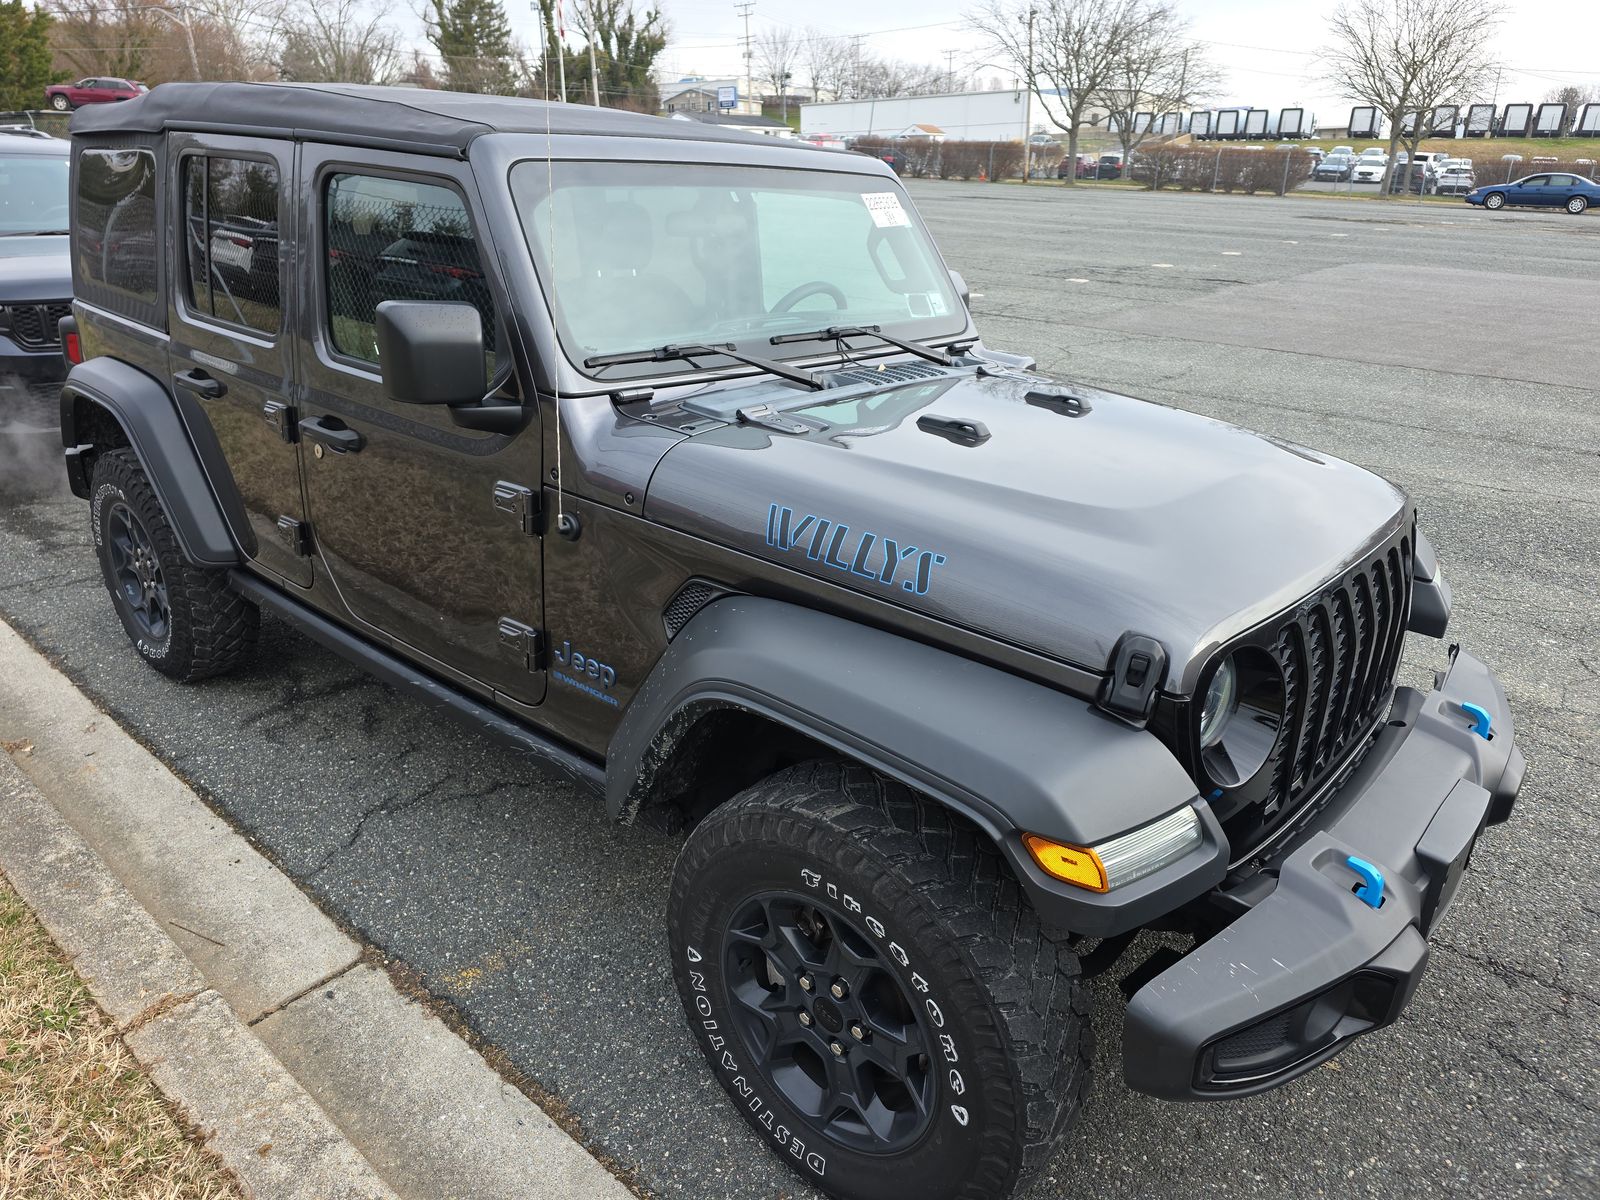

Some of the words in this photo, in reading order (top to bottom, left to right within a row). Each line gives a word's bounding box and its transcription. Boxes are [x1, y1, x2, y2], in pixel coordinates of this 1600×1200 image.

[766, 503, 947, 596] WILLYS
[554, 641, 616, 689] Jeep
[688, 971, 827, 1176] DESTINATION
